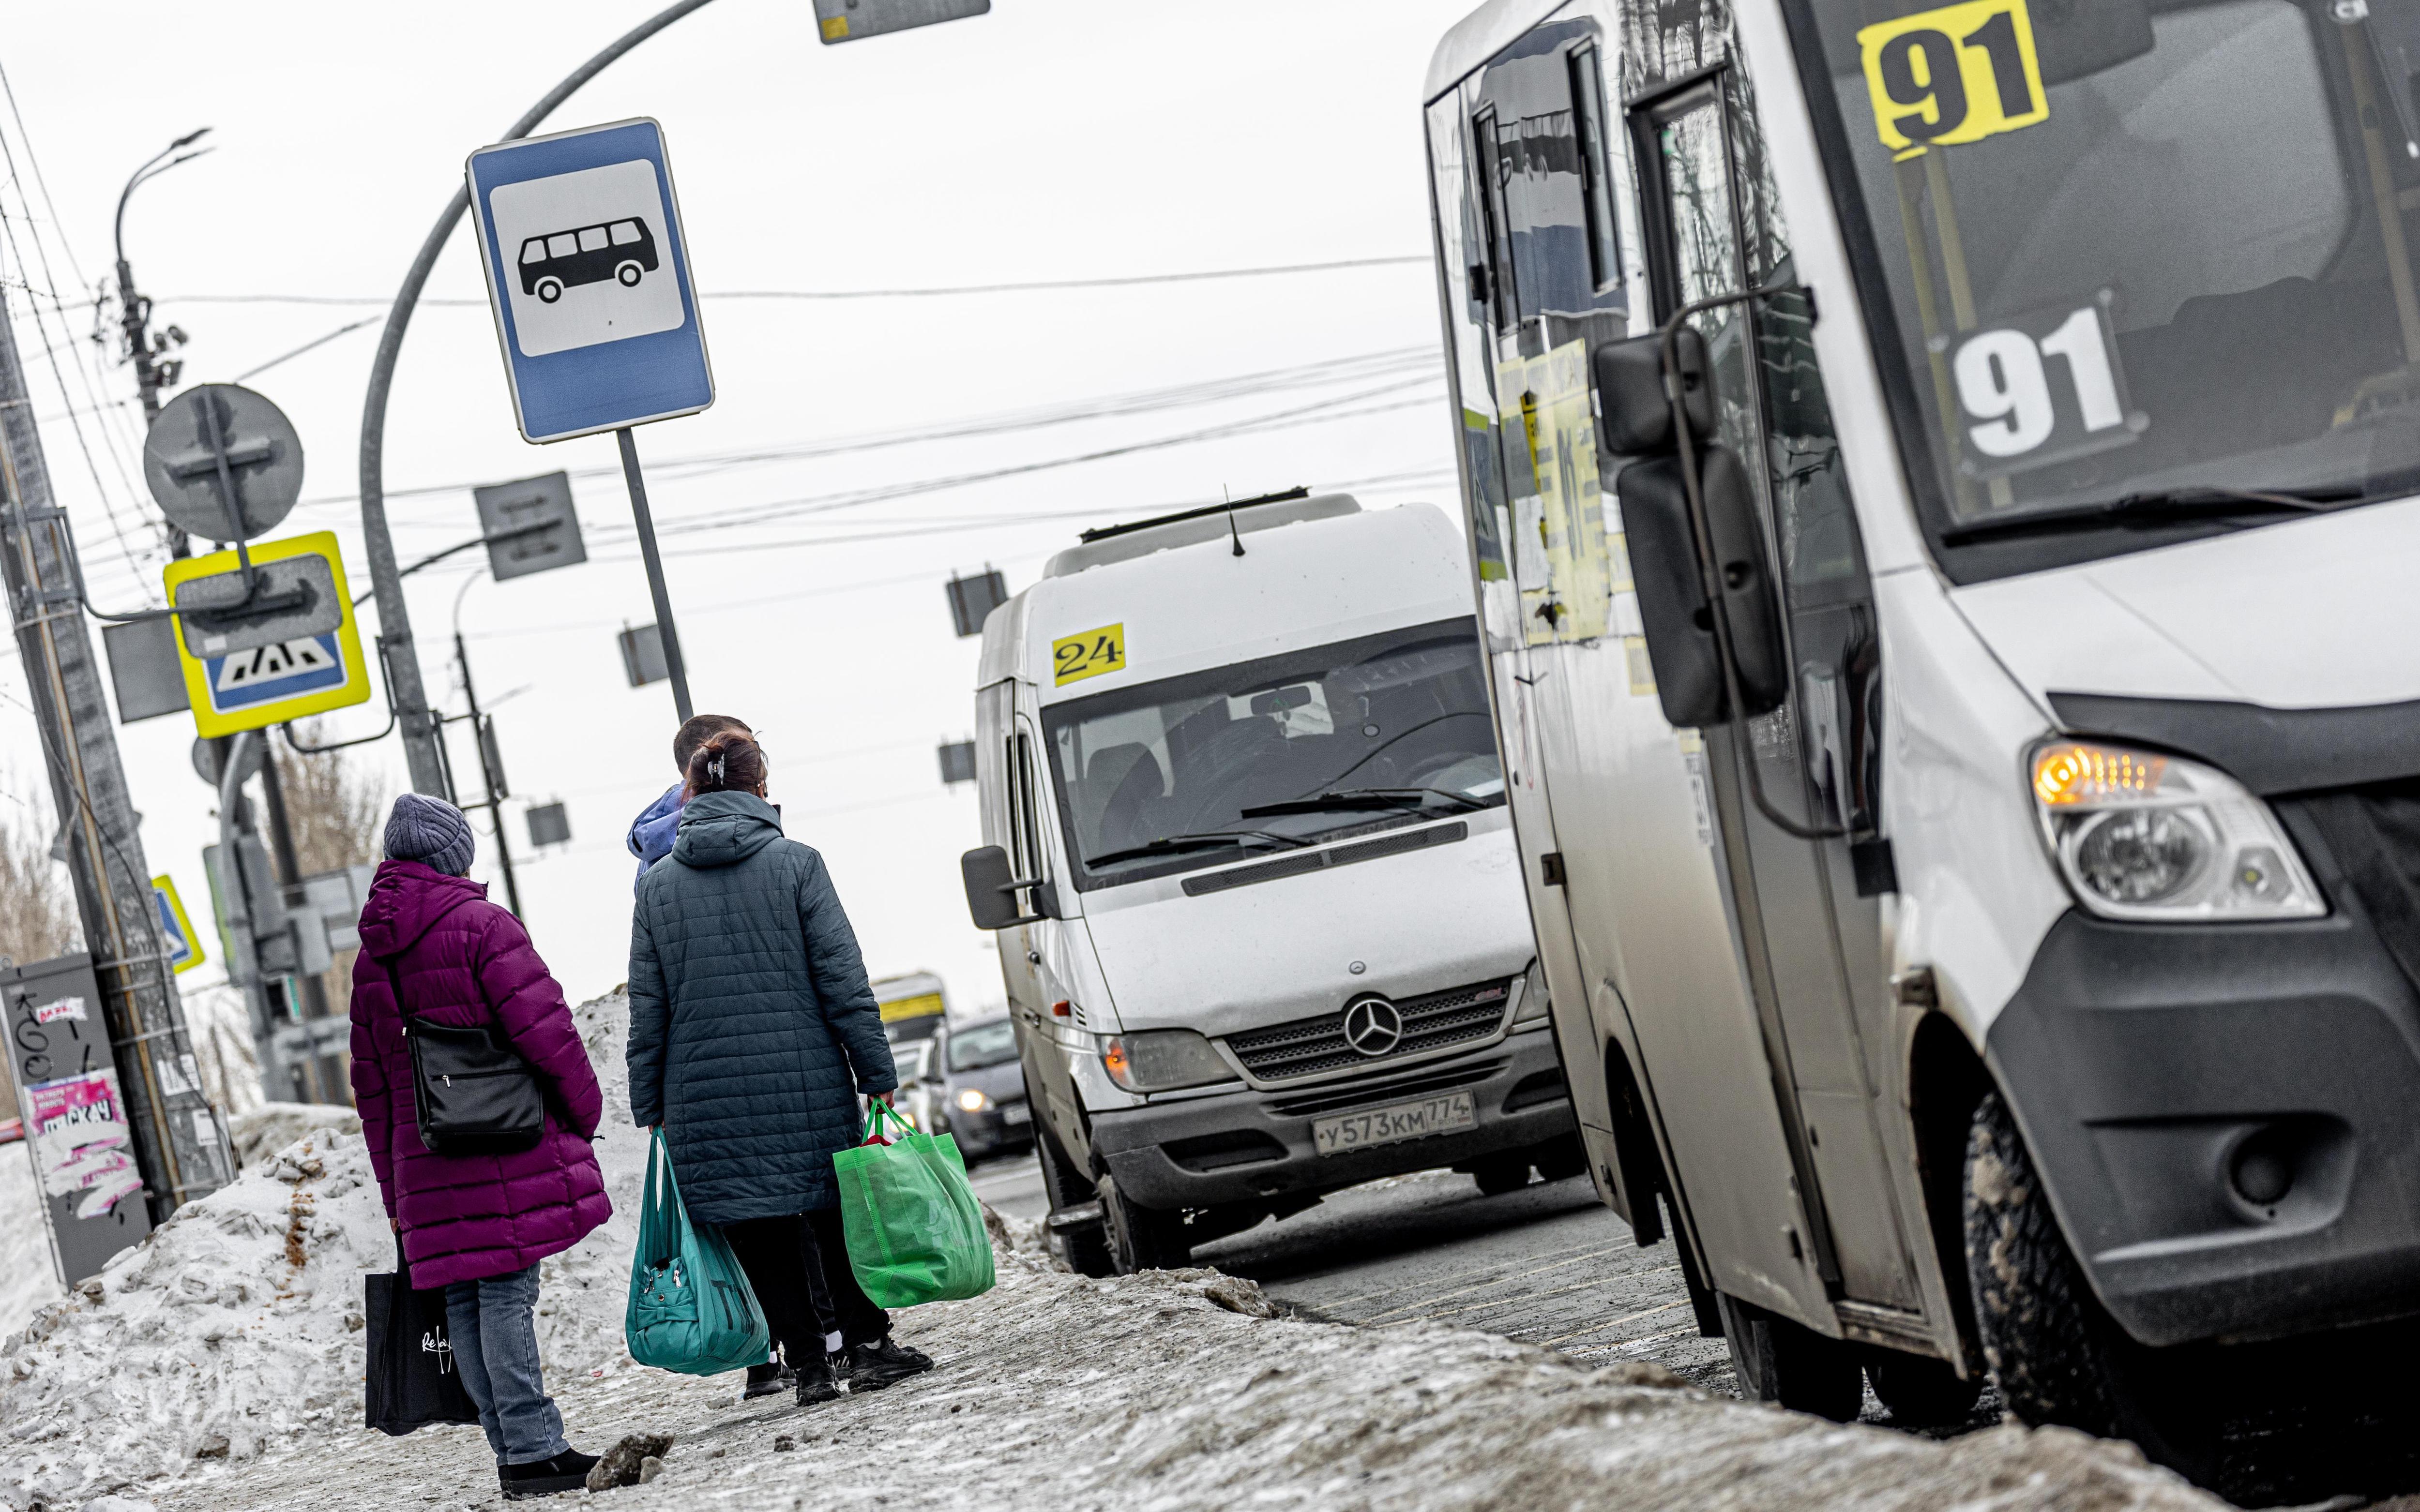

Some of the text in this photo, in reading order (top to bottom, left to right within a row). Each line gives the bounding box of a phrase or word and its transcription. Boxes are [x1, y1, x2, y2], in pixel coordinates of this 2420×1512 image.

[1880, 11, 2034, 140] 91
[1954, 307, 2123, 458] 91
[1055, 635, 1122, 678] 24
[1326, 1096, 1469, 1147] У573КМ 774
